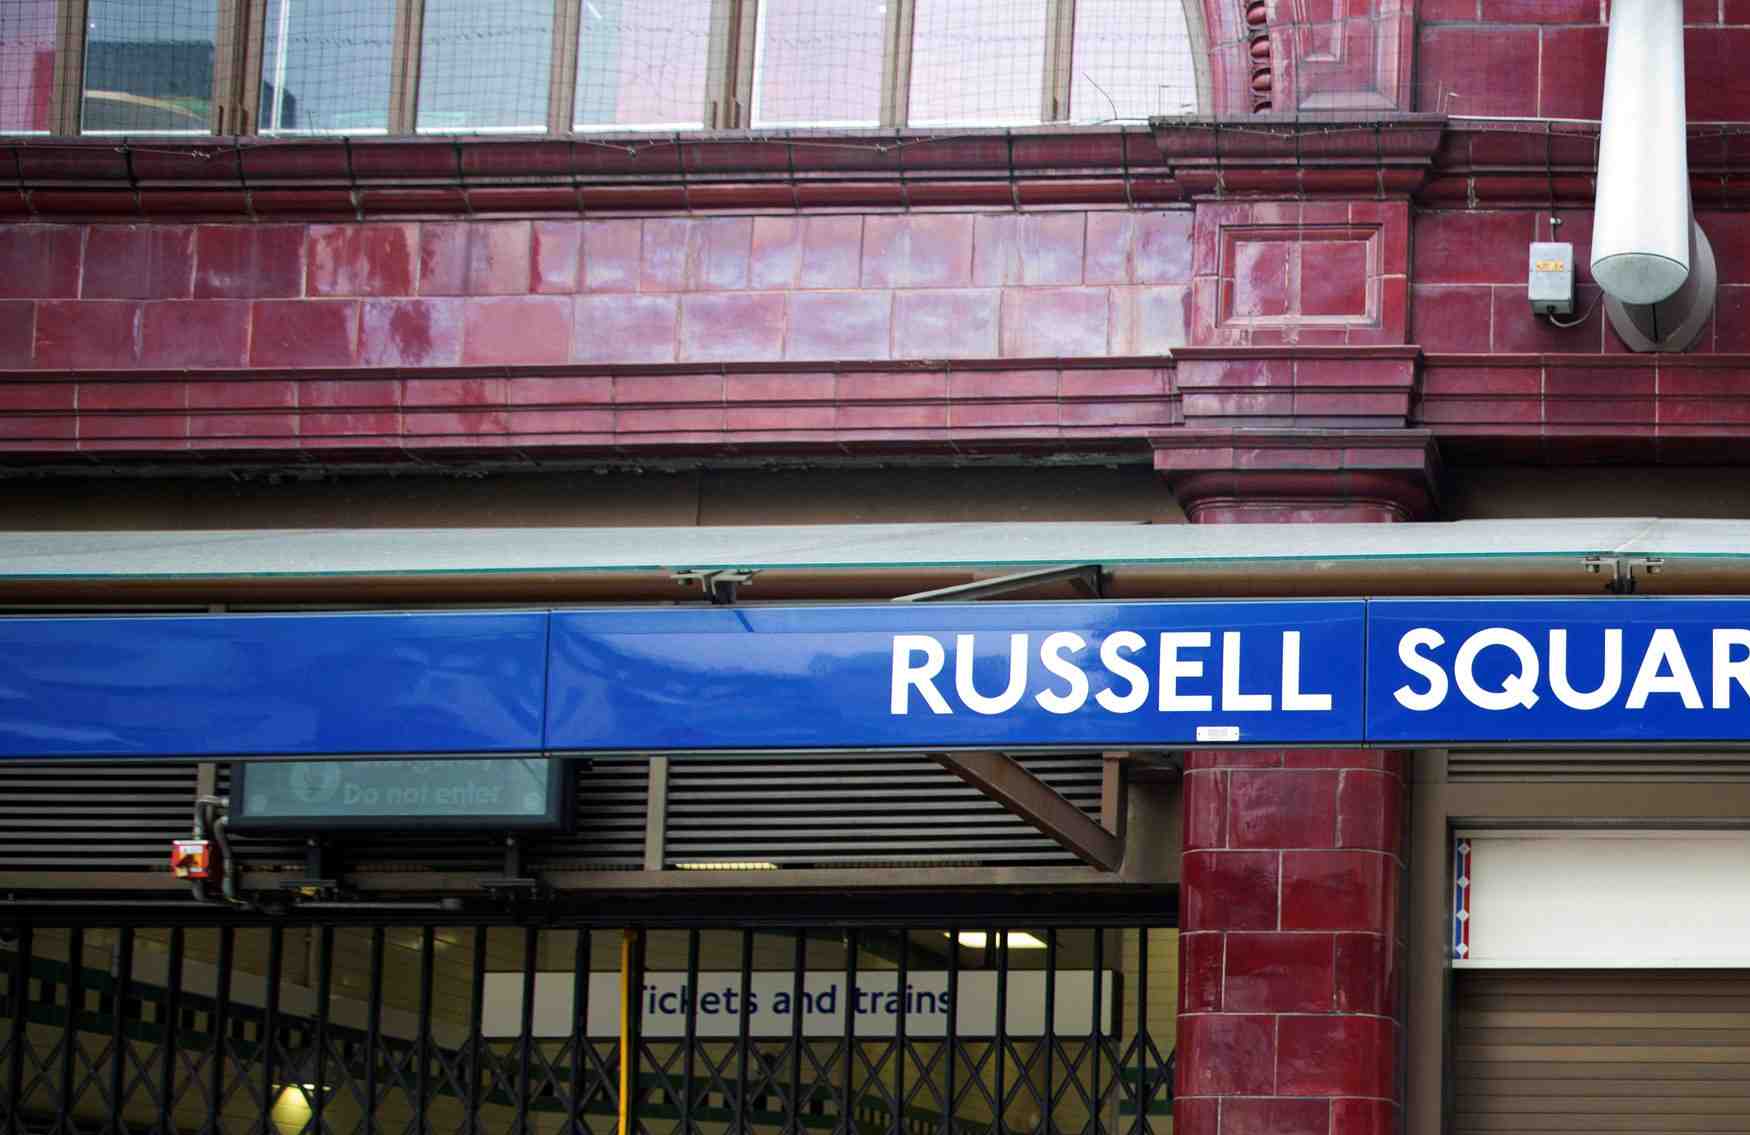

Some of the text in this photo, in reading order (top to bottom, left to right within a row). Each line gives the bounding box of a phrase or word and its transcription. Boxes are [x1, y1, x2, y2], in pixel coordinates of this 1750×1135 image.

[890, 630, 1333, 715] RUSSELL
[343, 780, 502, 807] Do not enter
[640, 984, 952, 1015] ickets and trains
